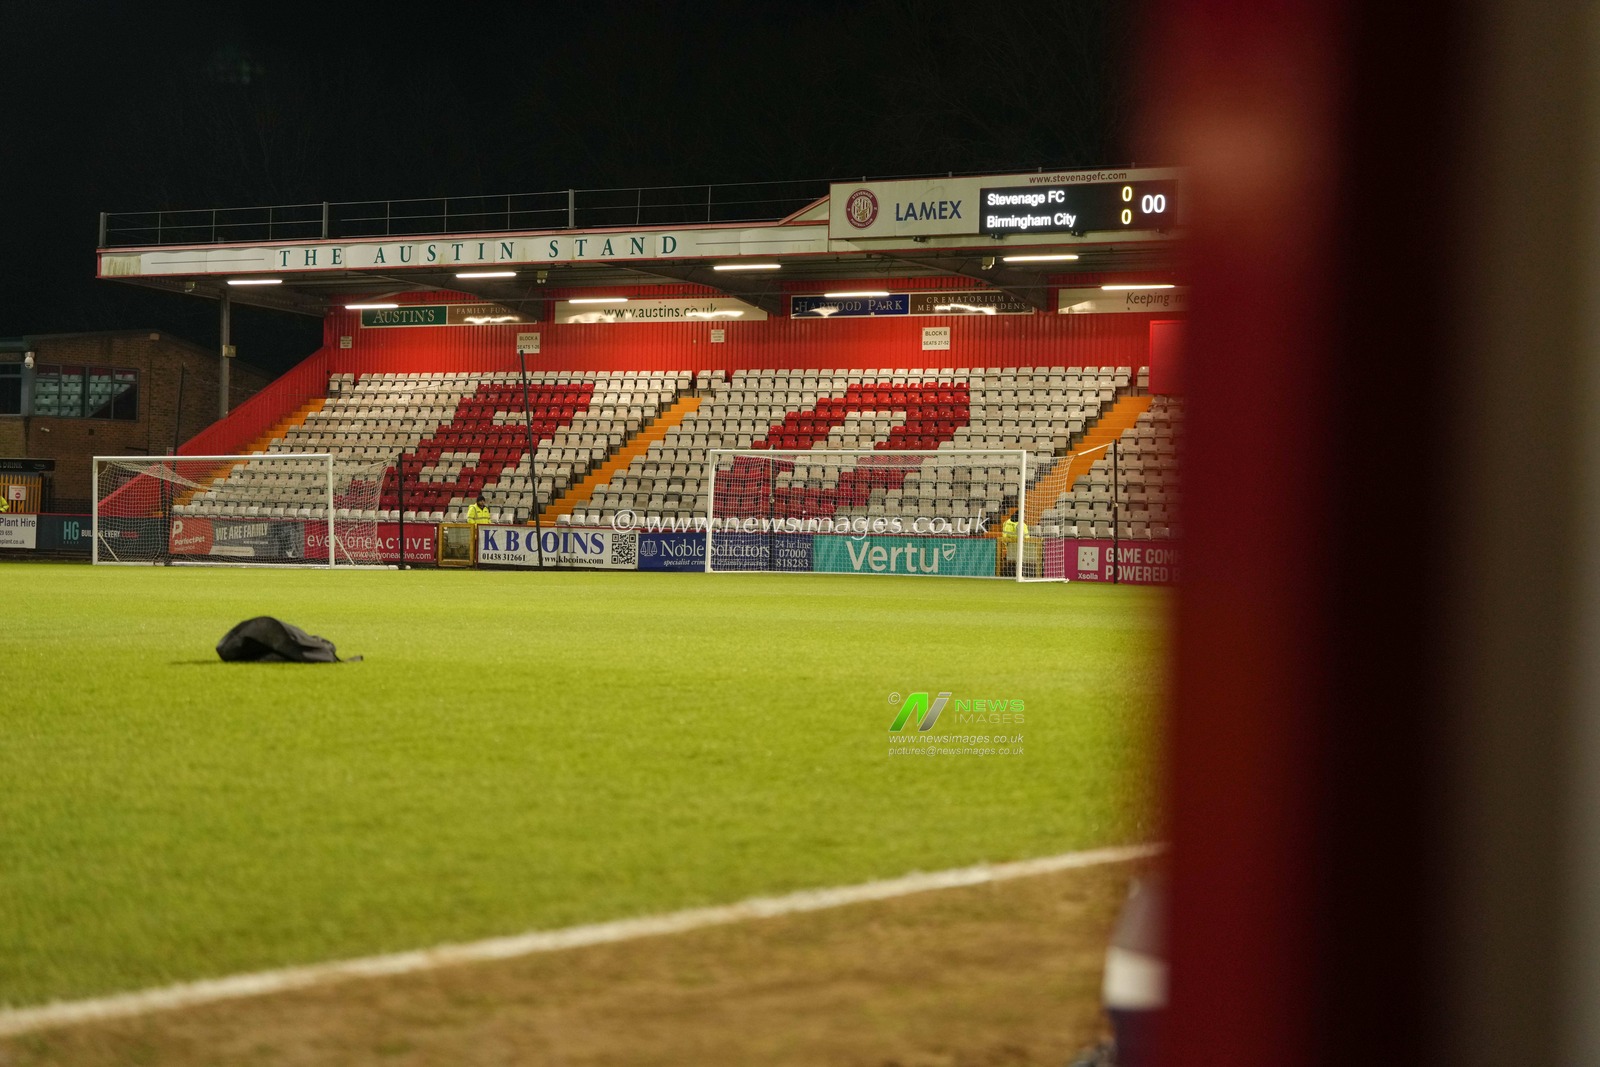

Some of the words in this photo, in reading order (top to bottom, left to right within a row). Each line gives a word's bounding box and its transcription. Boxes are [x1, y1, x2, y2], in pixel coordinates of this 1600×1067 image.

[1029, 172, 1127, 184] www.stevenagefc.com
[987, 192, 1045, 206] Stevenage
[1048, 190, 1065, 203] FC
[1121, 186, 1133, 202] 0
[1141, 194, 1166, 214] 00
[895, 200, 962, 221] LAMEX
[986, 215, 1051, 229] Birmingham
[1054, 212, 1076, 227] City
[1121, 209, 1132, 225] 0
[279, 248, 342, 267] THE
[373, 242, 515, 264] AUSTIN
[548, 235, 677, 258] STAND
[867, 299, 903, 311] PARK
[926, 295, 1005, 304] CREMATORIUM
[1126, 292, 1170, 307] Keeping
[372, 308, 435, 324] AUSTIN'S
[456, 307, 486, 315] FAMILY
[603, 303, 717, 319] www.austins.couk
[0, 517, 19, 527] Plant
[20, 517, 36, 528] Hire
[63, 521, 79, 540] HG
[215, 528, 228, 541] WE
[228, 525, 242, 540] ARE
[243, 522, 269, 539] FAMILY
[483, 529, 499, 551] K
[505, 530, 520, 552] B
[525, 530, 605, 555] COINS
[660, 538, 705, 557] Noble
[709, 539, 771, 558] Solicitors
[775, 540, 785, 548] 24
[786, 540, 794, 549] hr
[482, 553, 502, 561] 01438
[502, 554, 526, 562] 312661
[543, 555, 604, 565] ww.kbcoins.com
[778, 549, 807, 558] 07000
[845, 540, 939, 574] Vertu
[1105, 547, 1142, 563] GAME
[1145, 548, 1179, 565] COM
[663, 559, 690, 567] specialist
[776, 558, 809, 568] 818283
[1105, 565, 1169, 582] POWERED
